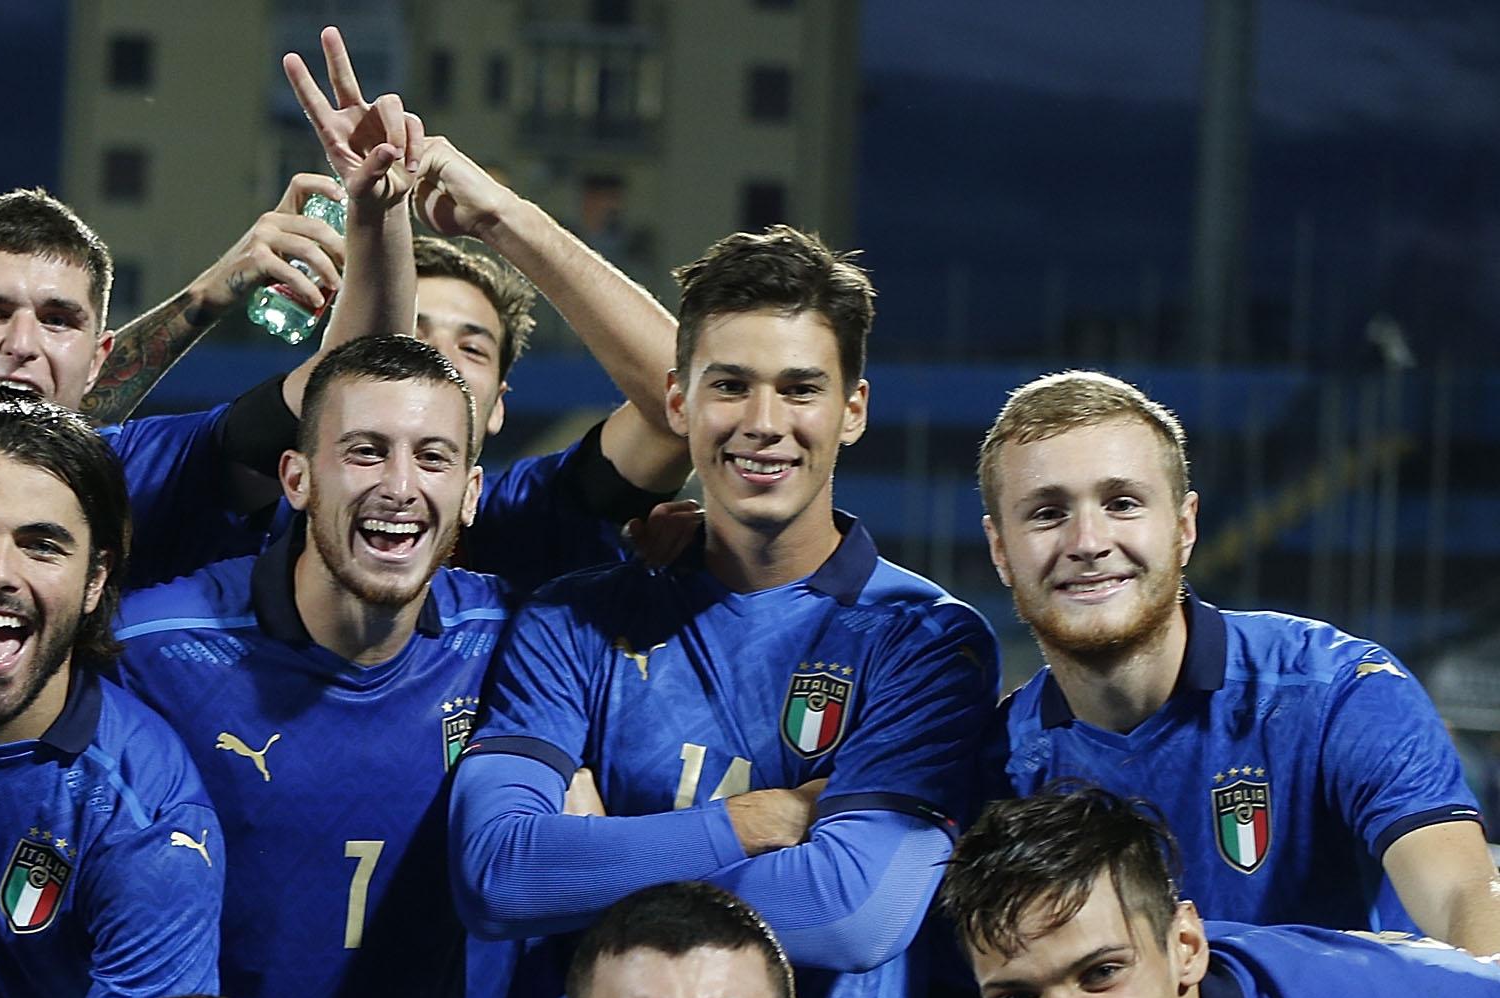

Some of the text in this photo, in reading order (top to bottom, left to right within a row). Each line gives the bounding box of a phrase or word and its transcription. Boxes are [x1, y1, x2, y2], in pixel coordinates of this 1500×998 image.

[795, 679, 846, 697] ITALIA
[447, 719, 472, 735] ITAL
[1218, 789, 1265, 806] ITALIA
[20, 847, 68, 879] ITALIA
[344, 840, 385, 949] 7
